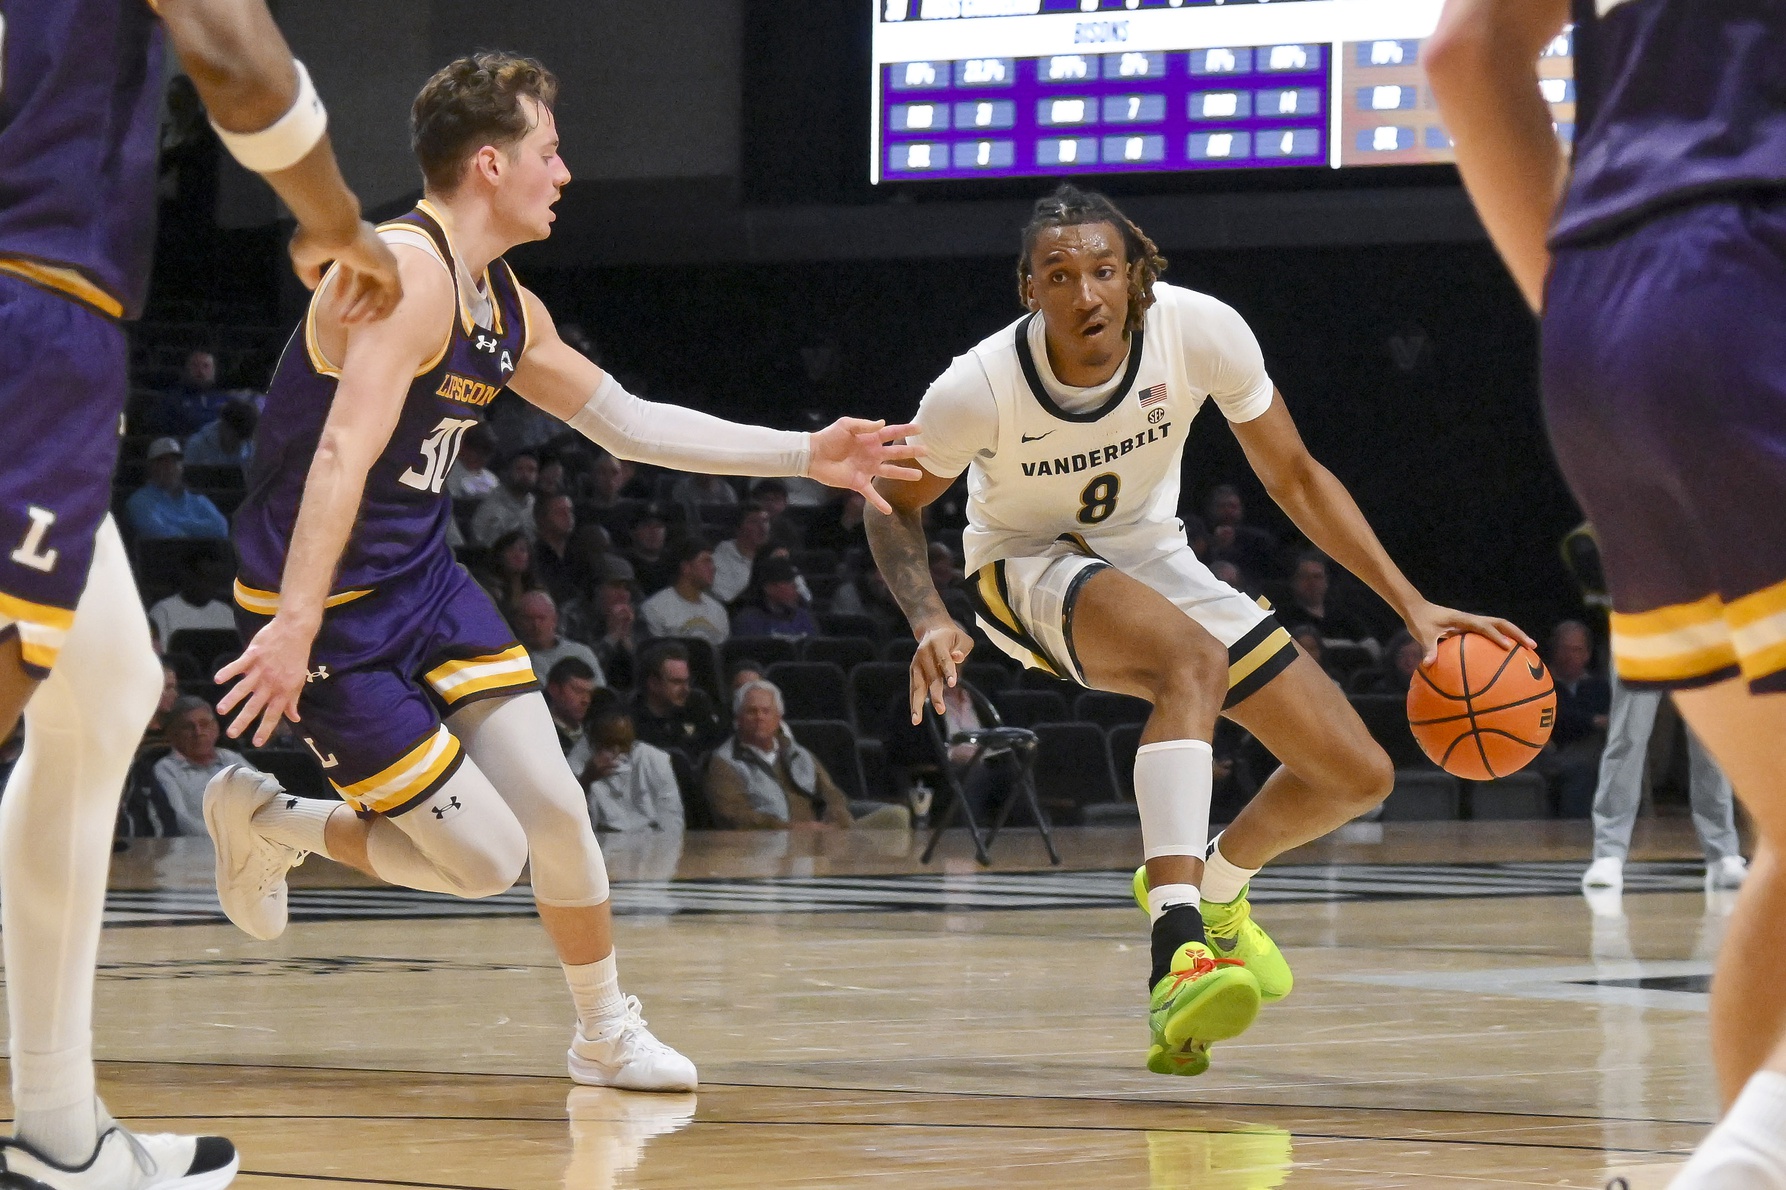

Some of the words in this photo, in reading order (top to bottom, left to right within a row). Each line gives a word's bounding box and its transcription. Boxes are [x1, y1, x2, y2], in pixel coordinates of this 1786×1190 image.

[1149, 408, 1164, 424] SEC
[398, 417, 478, 493] 30
[1021, 422, 1172, 477] VANDERBILT
[1076, 472, 1121, 526] 8
[12, 506, 57, 572] L
[303, 737, 339, 768] L
